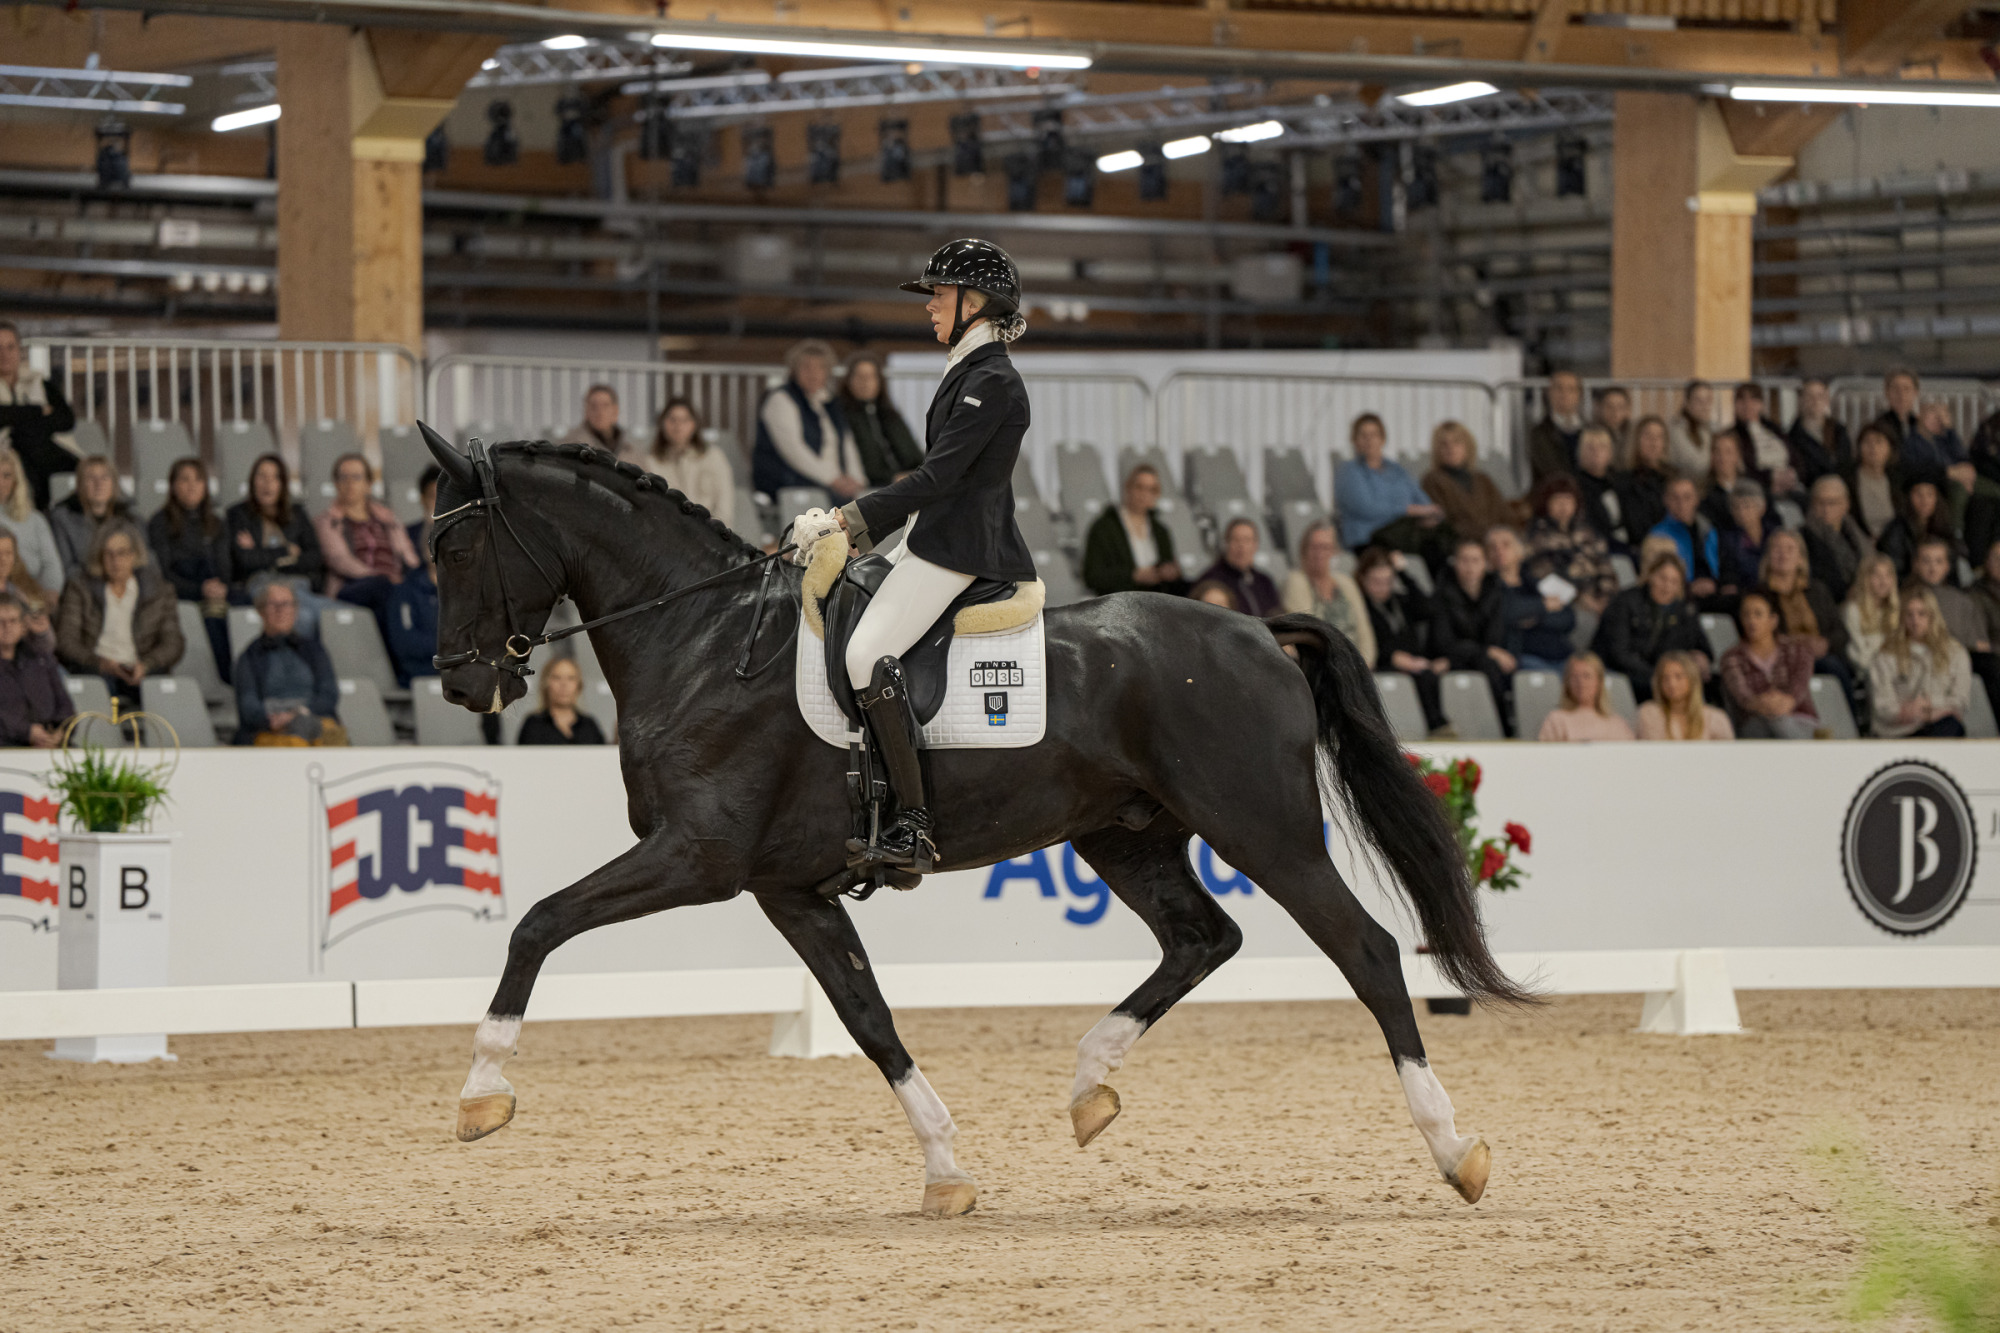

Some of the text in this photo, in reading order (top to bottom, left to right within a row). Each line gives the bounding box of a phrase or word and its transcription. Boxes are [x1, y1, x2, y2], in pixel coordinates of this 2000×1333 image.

[973, 671, 1020, 683] 0935
[69, 865, 87, 910] B
[120, 866, 150, 910] B
